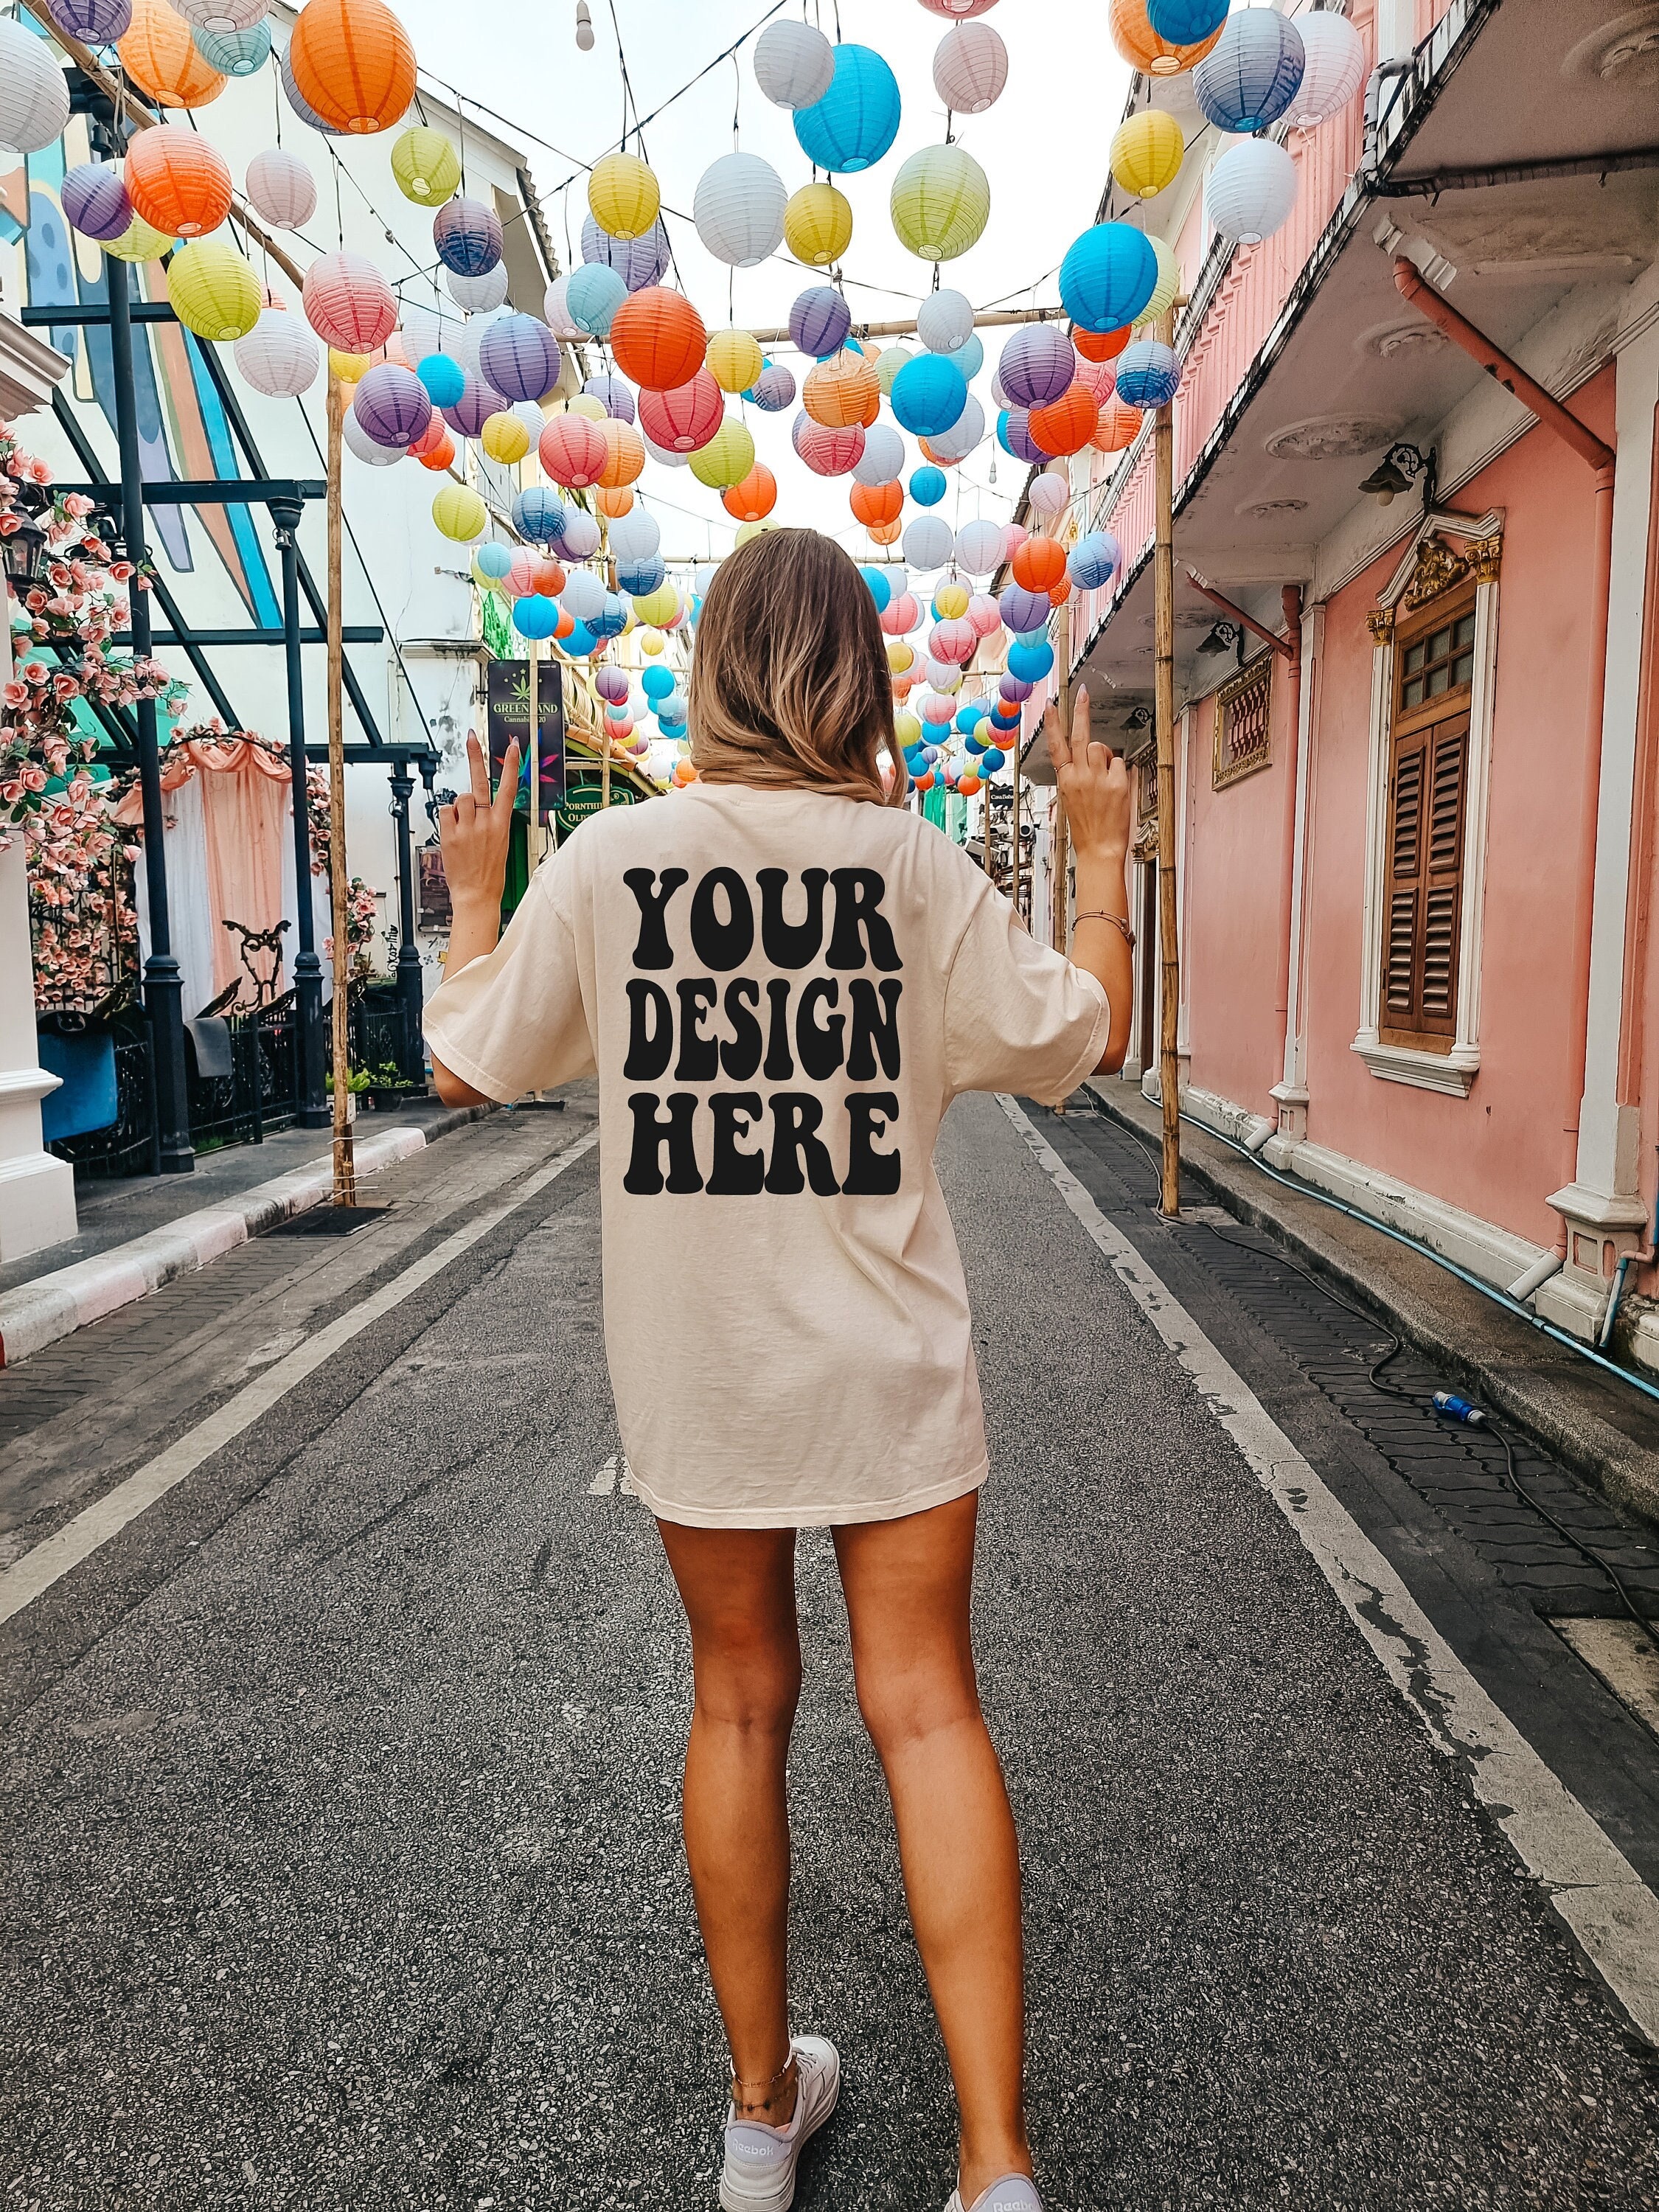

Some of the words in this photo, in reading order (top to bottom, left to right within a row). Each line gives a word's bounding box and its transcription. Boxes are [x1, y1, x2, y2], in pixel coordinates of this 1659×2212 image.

[493, 703, 558, 714] GREENAND
[568, 813, 591, 822] OLD
[623, 866, 904, 973] YOUR
[623, 977, 903, 1082] DESIGN
[623, 1091, 902, 1197] HERE
[732, 2138, 773, 2155] Reebok
